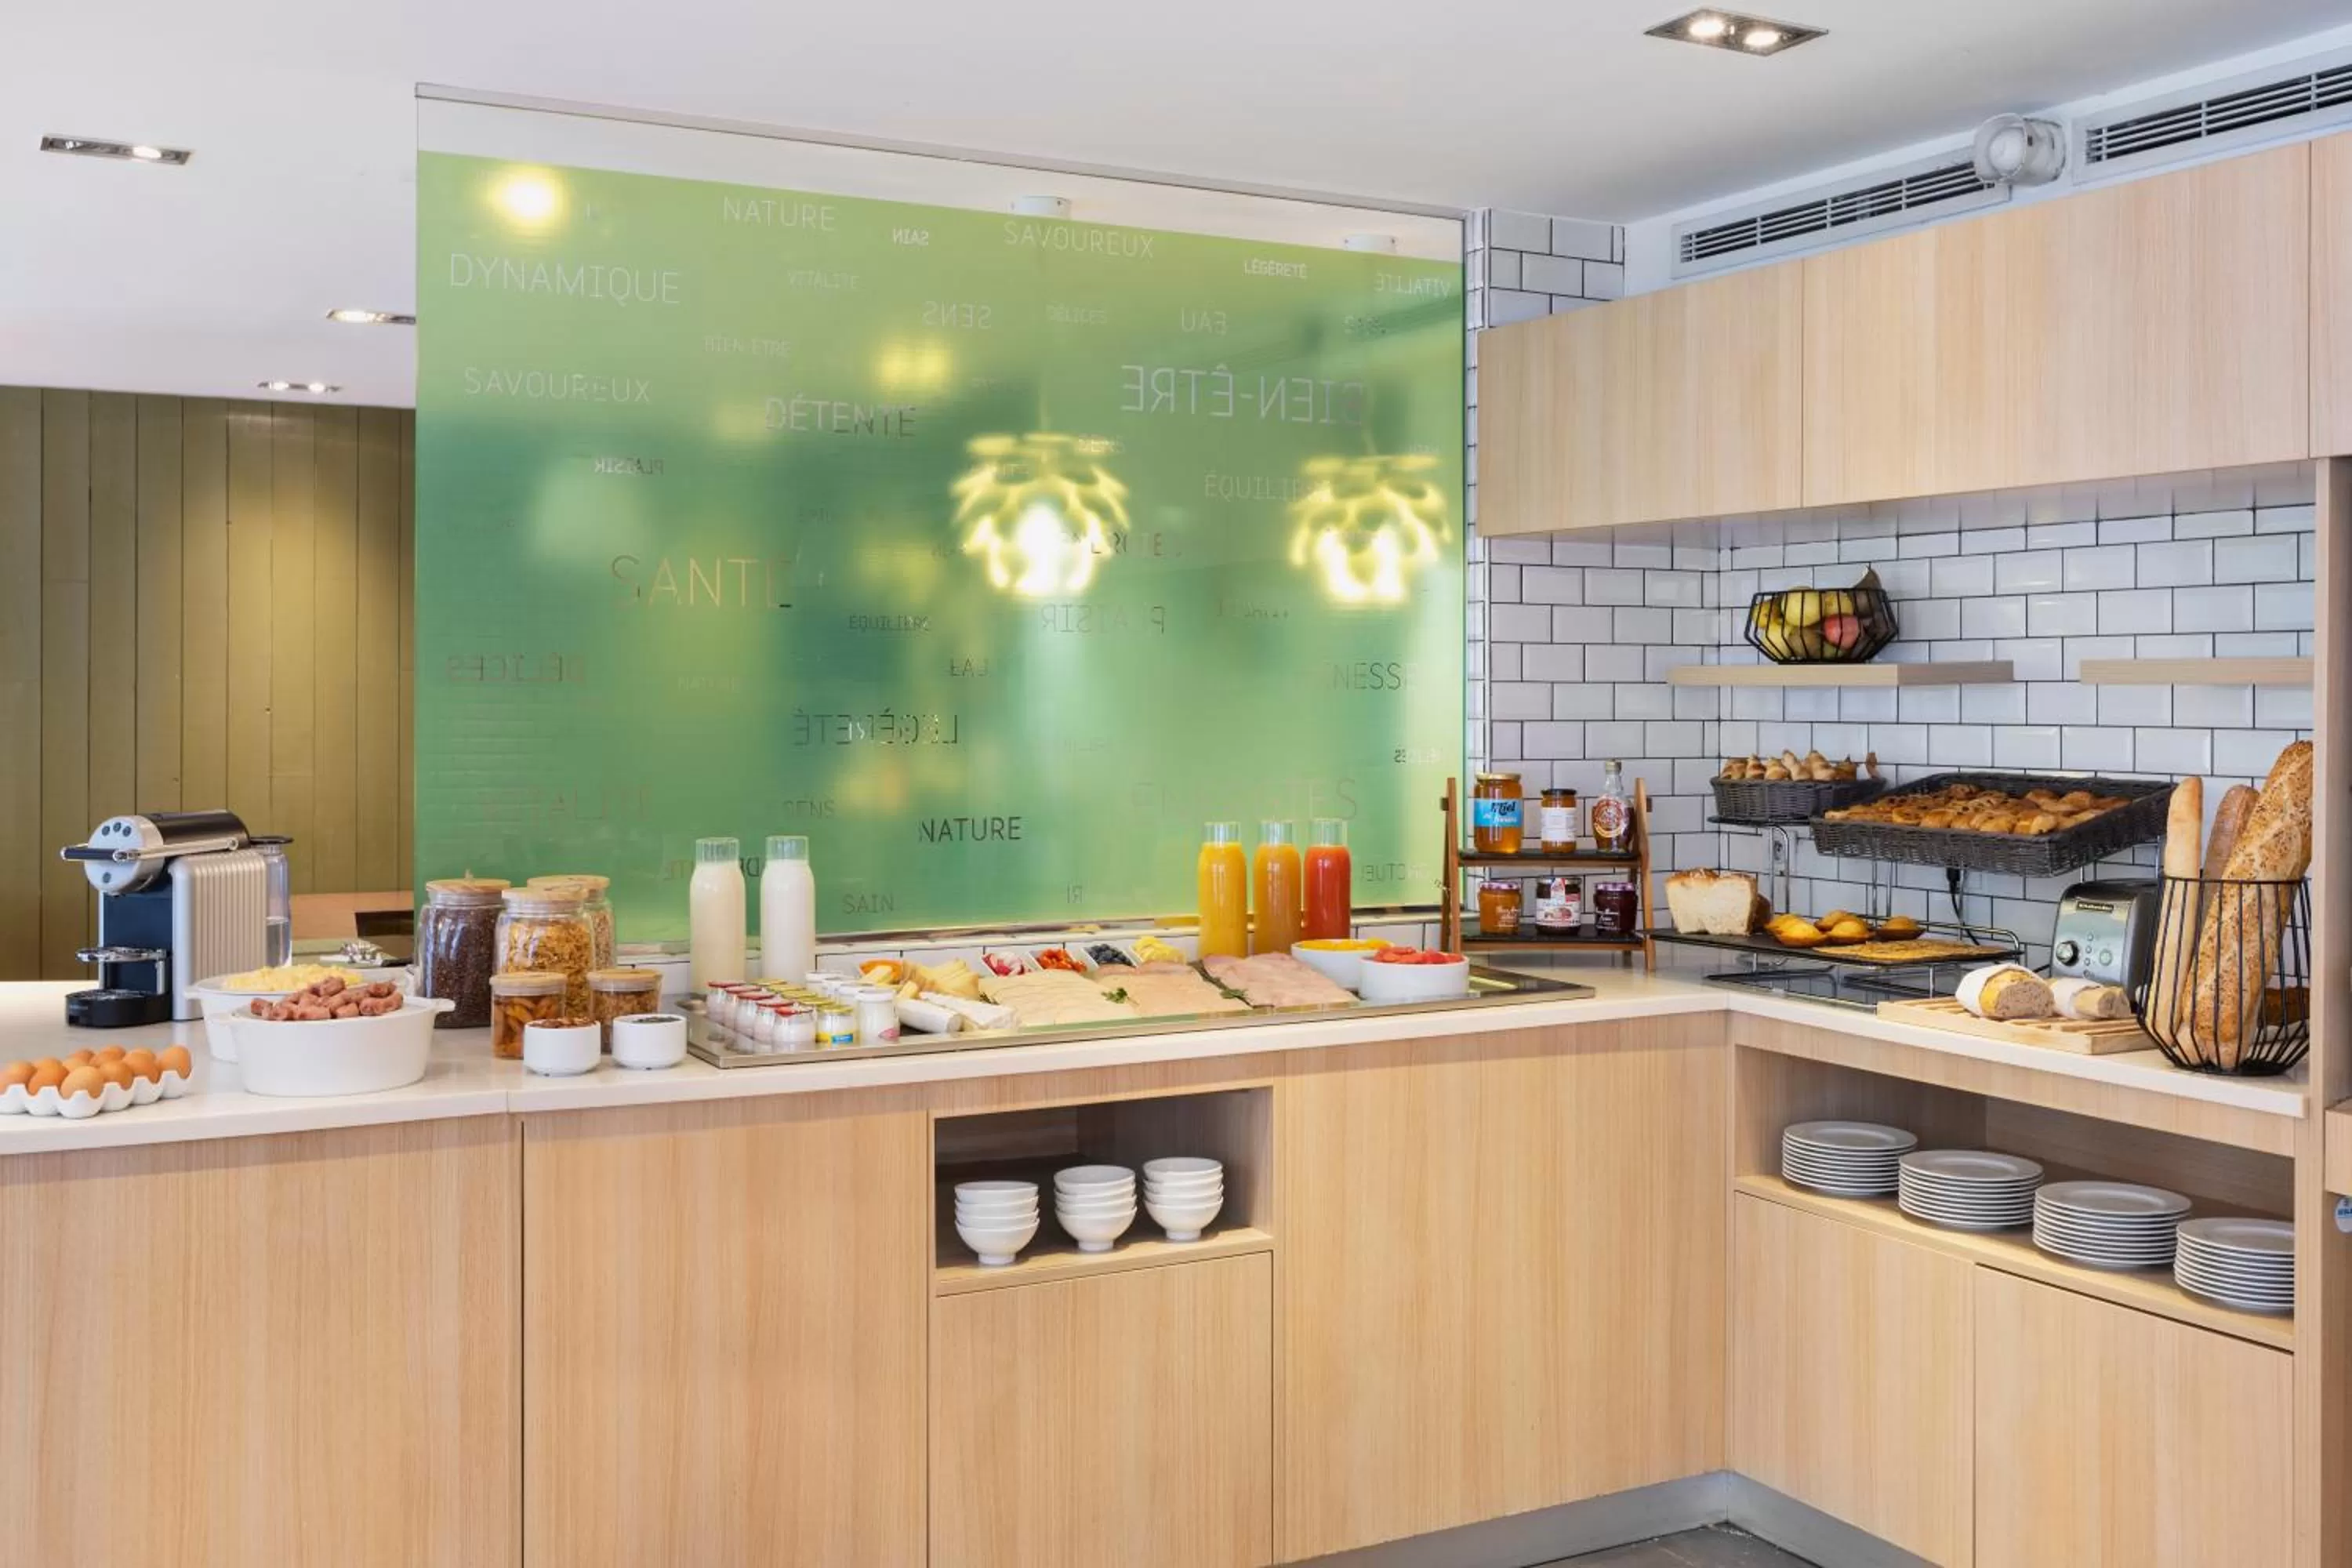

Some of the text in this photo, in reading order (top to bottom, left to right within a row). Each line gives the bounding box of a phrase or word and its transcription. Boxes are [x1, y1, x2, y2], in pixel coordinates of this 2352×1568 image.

[722, 196, 837, 232] NATURE
[1003, 220, 1155, 260] SAVOUREUX
[450, 252, 682, 307] DYNAMIQUE
[465, 366, 653, 404] SAVOUREUX
[764, 392, 917, 439] DÉTENTE
[919, 815, 1023, 844] NATURE
[841, 892, 896, 915] SAIN
